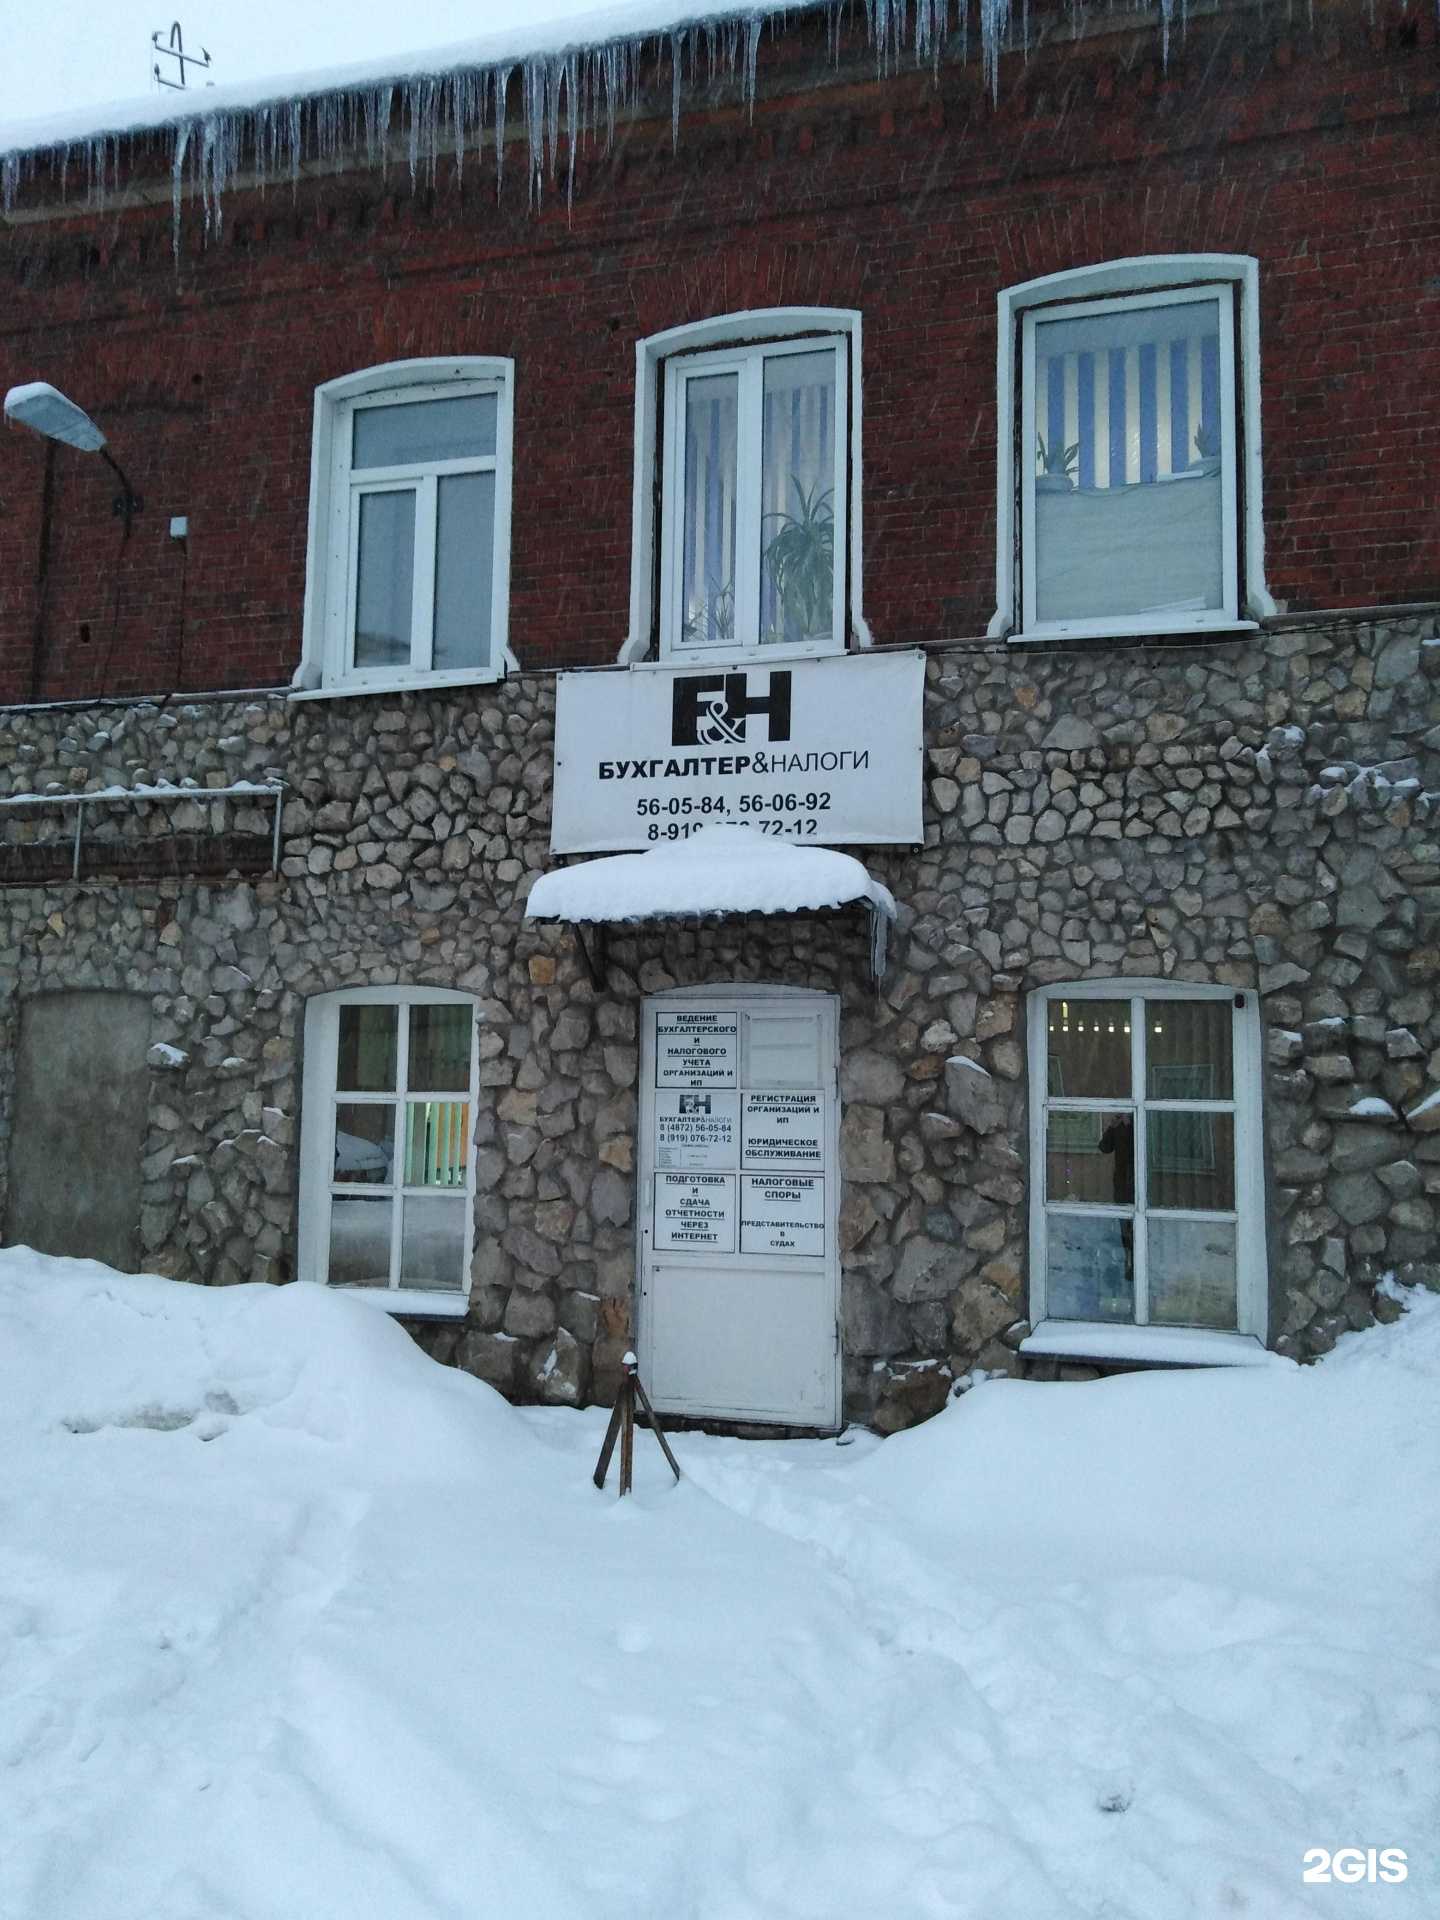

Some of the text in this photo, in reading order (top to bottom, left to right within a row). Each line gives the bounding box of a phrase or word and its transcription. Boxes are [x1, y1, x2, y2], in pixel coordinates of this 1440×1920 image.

[599, 750, 869, 780] БУХГАЛТЕР&НАЛОГИ
[637, 792, 831, 817] 56-05-84, 56-06-92
[658, 1025, 737, 1033] БУХГАЛТЕРСКОГО
[750, 1095, 816, 1103] РЕГИСТРАЦИЯ
[659, 1123, 732, 1133] 8 (4872) 56-05-84
[659, 1134, 732, 1143] 8 (919) 076-72-12
[748, 1138, 818, 1147] ЮРИДИЧЕСКОЕ
[745, 1149, 822, 1158] ОБСЛУЖИВАНИЕ
[665, 1175, 725, 1184] ПОДГОТОВКА
[751, 1178, 814, 1187] НАЛОГОВЫЕ
[764, 1191, 801, 1199] СПОРЫ
[679, 1198, 710, 1207] СДАЧА
[665, 1209, 725, 1218] ОТЧЕТНОСТИ
[680, 1221, 709, 1229] ЧЕРЕЗ
[741, 1220, 825, 1229] ПРЕДСТАВИТЕЛЬСТВО
[671, 1232, 718, 1241] ИНТЕРНЕТ
[770, 1240, 795, 1248] СУДАХ
